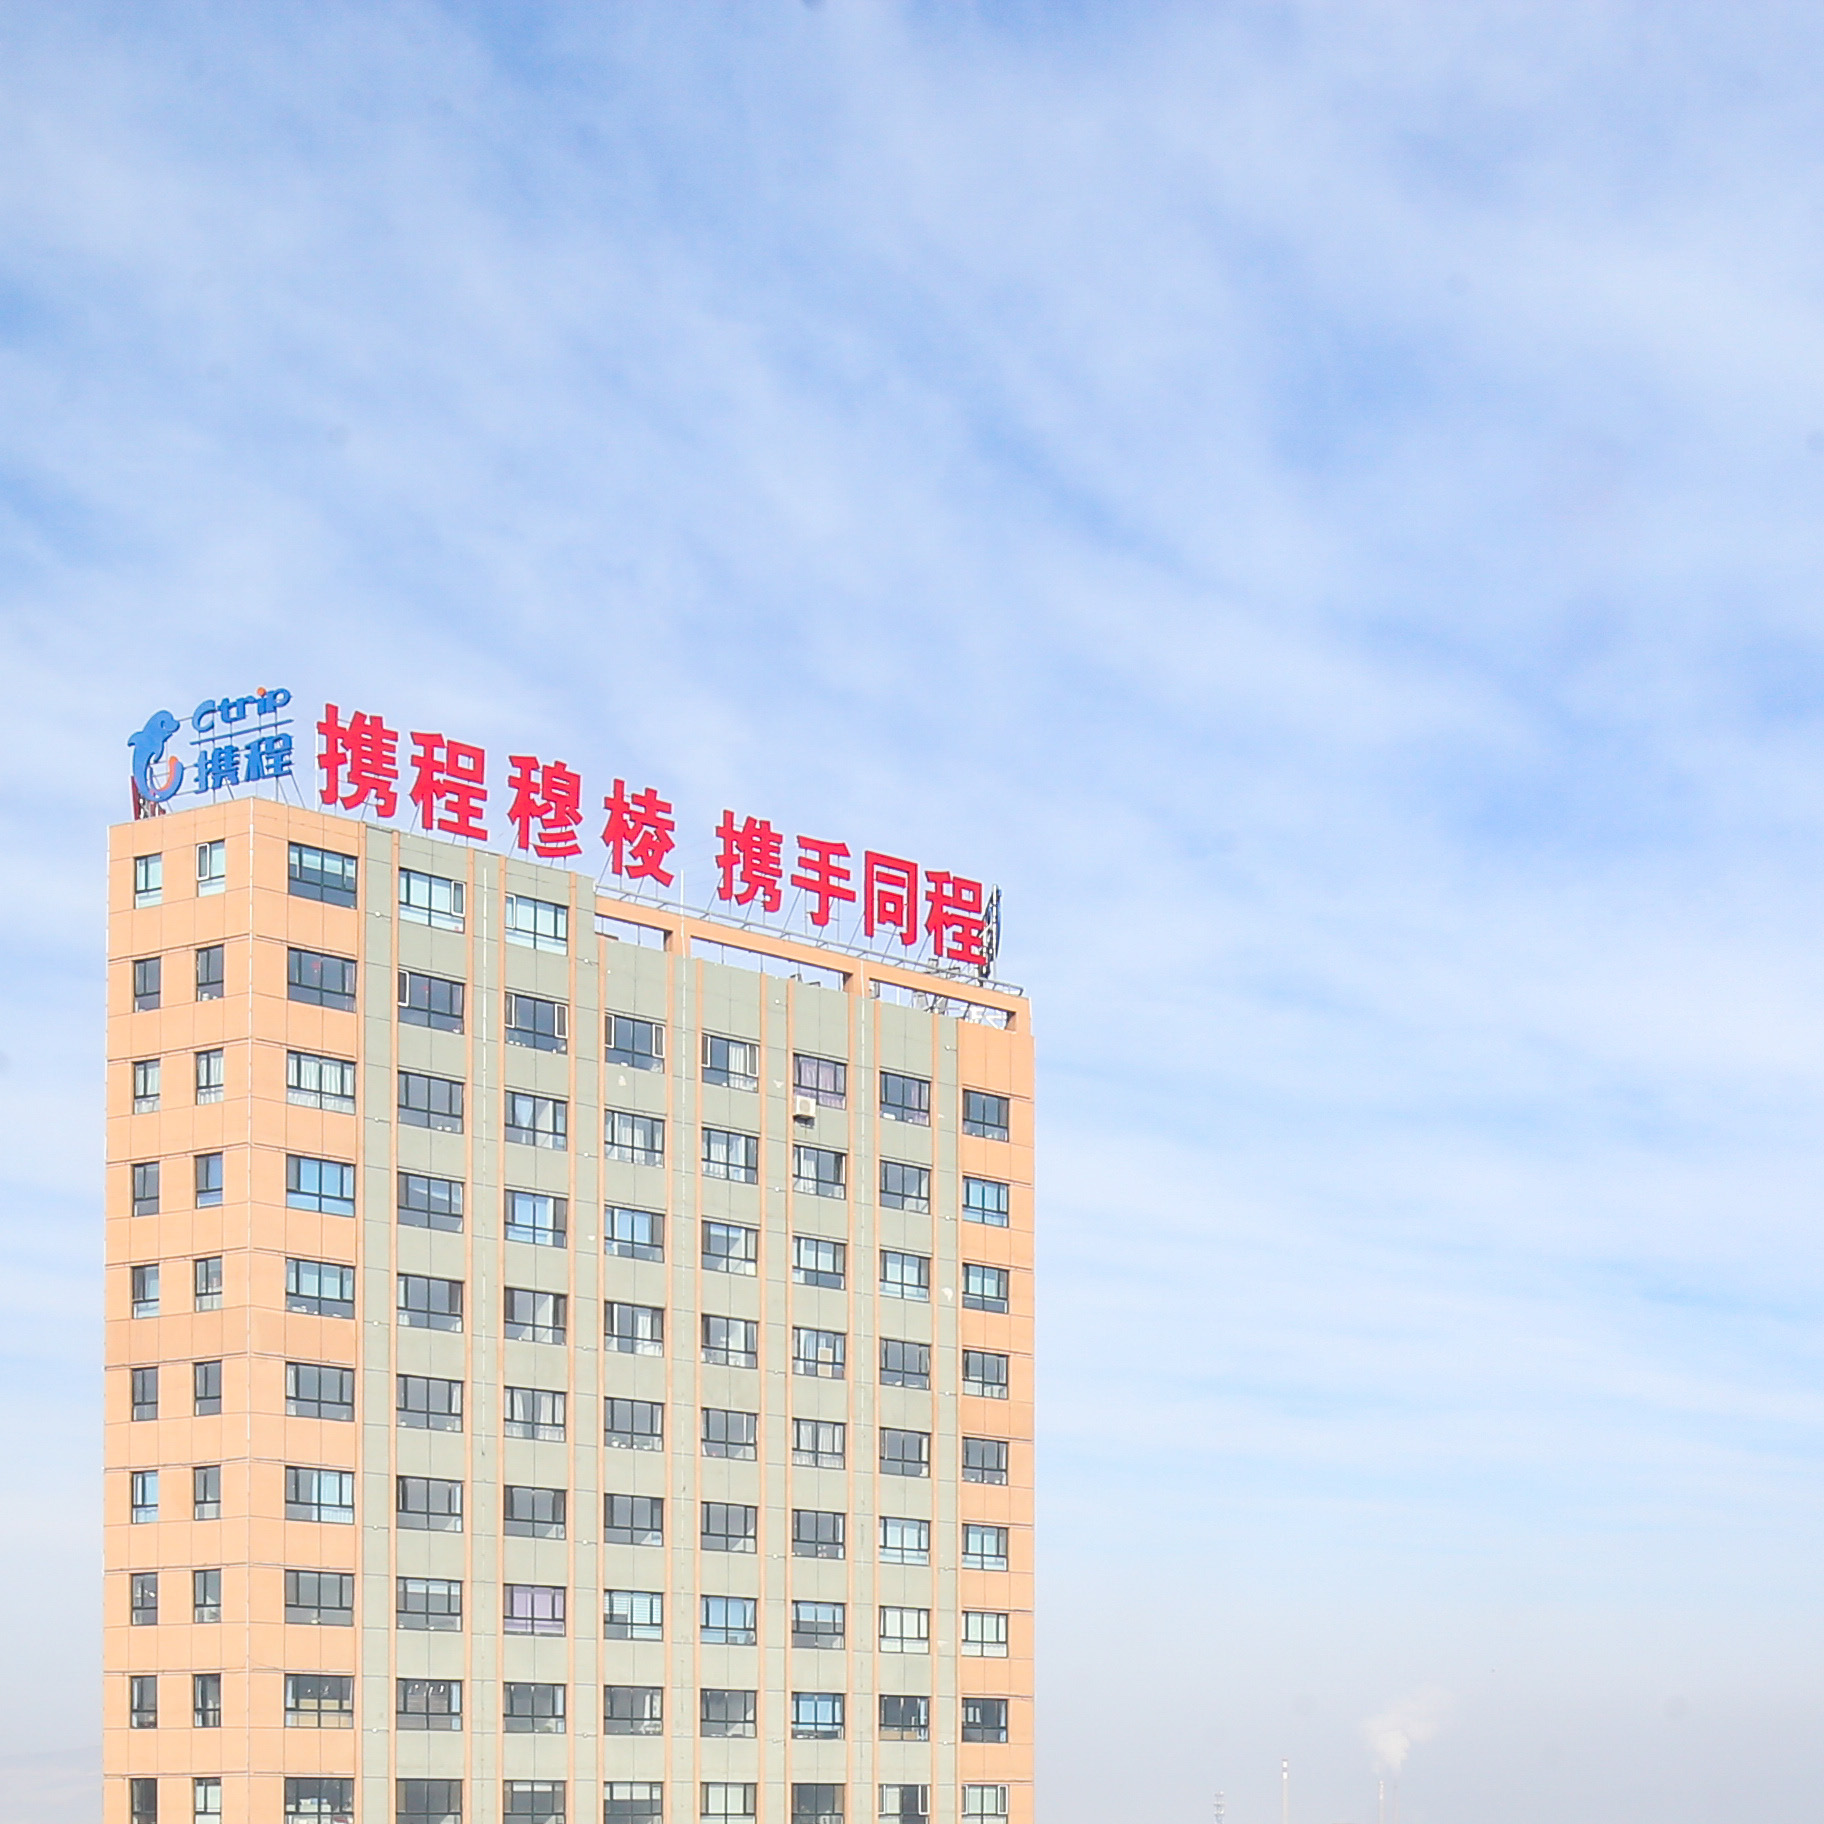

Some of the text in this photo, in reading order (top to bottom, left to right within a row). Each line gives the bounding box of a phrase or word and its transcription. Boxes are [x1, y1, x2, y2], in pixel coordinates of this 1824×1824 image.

[191, 686, 291, 734] Ctrip
[193, 732, 293, 793] 携程
[316, 702, 989, 967] 携程穆棱 携手同程
